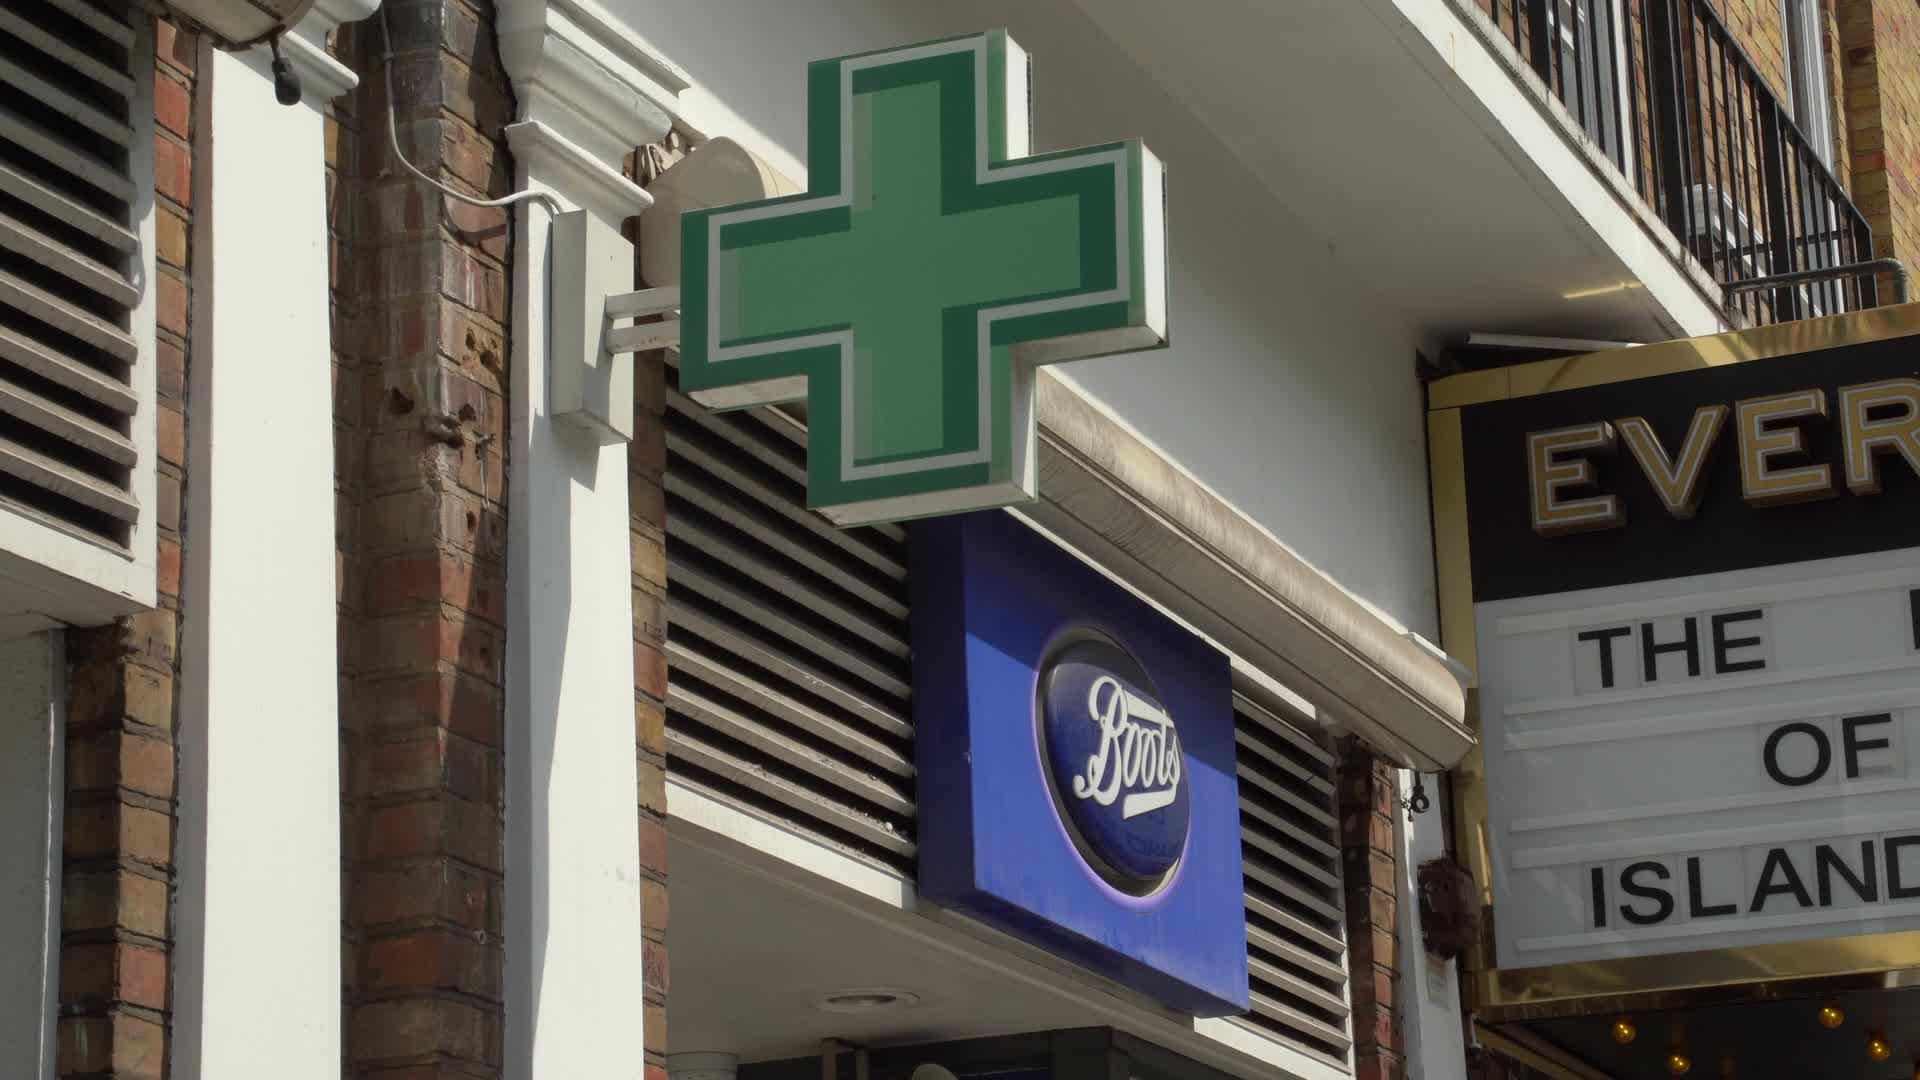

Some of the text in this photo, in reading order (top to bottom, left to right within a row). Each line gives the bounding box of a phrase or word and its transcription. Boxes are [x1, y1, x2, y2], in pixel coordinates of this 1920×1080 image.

[1526, 378, 1920, 536] EVER
[1578, 609, 1766, 688] THE
[1073, 676, 1181, 820] Boots
[1763, 713, 1892, 786] OF
